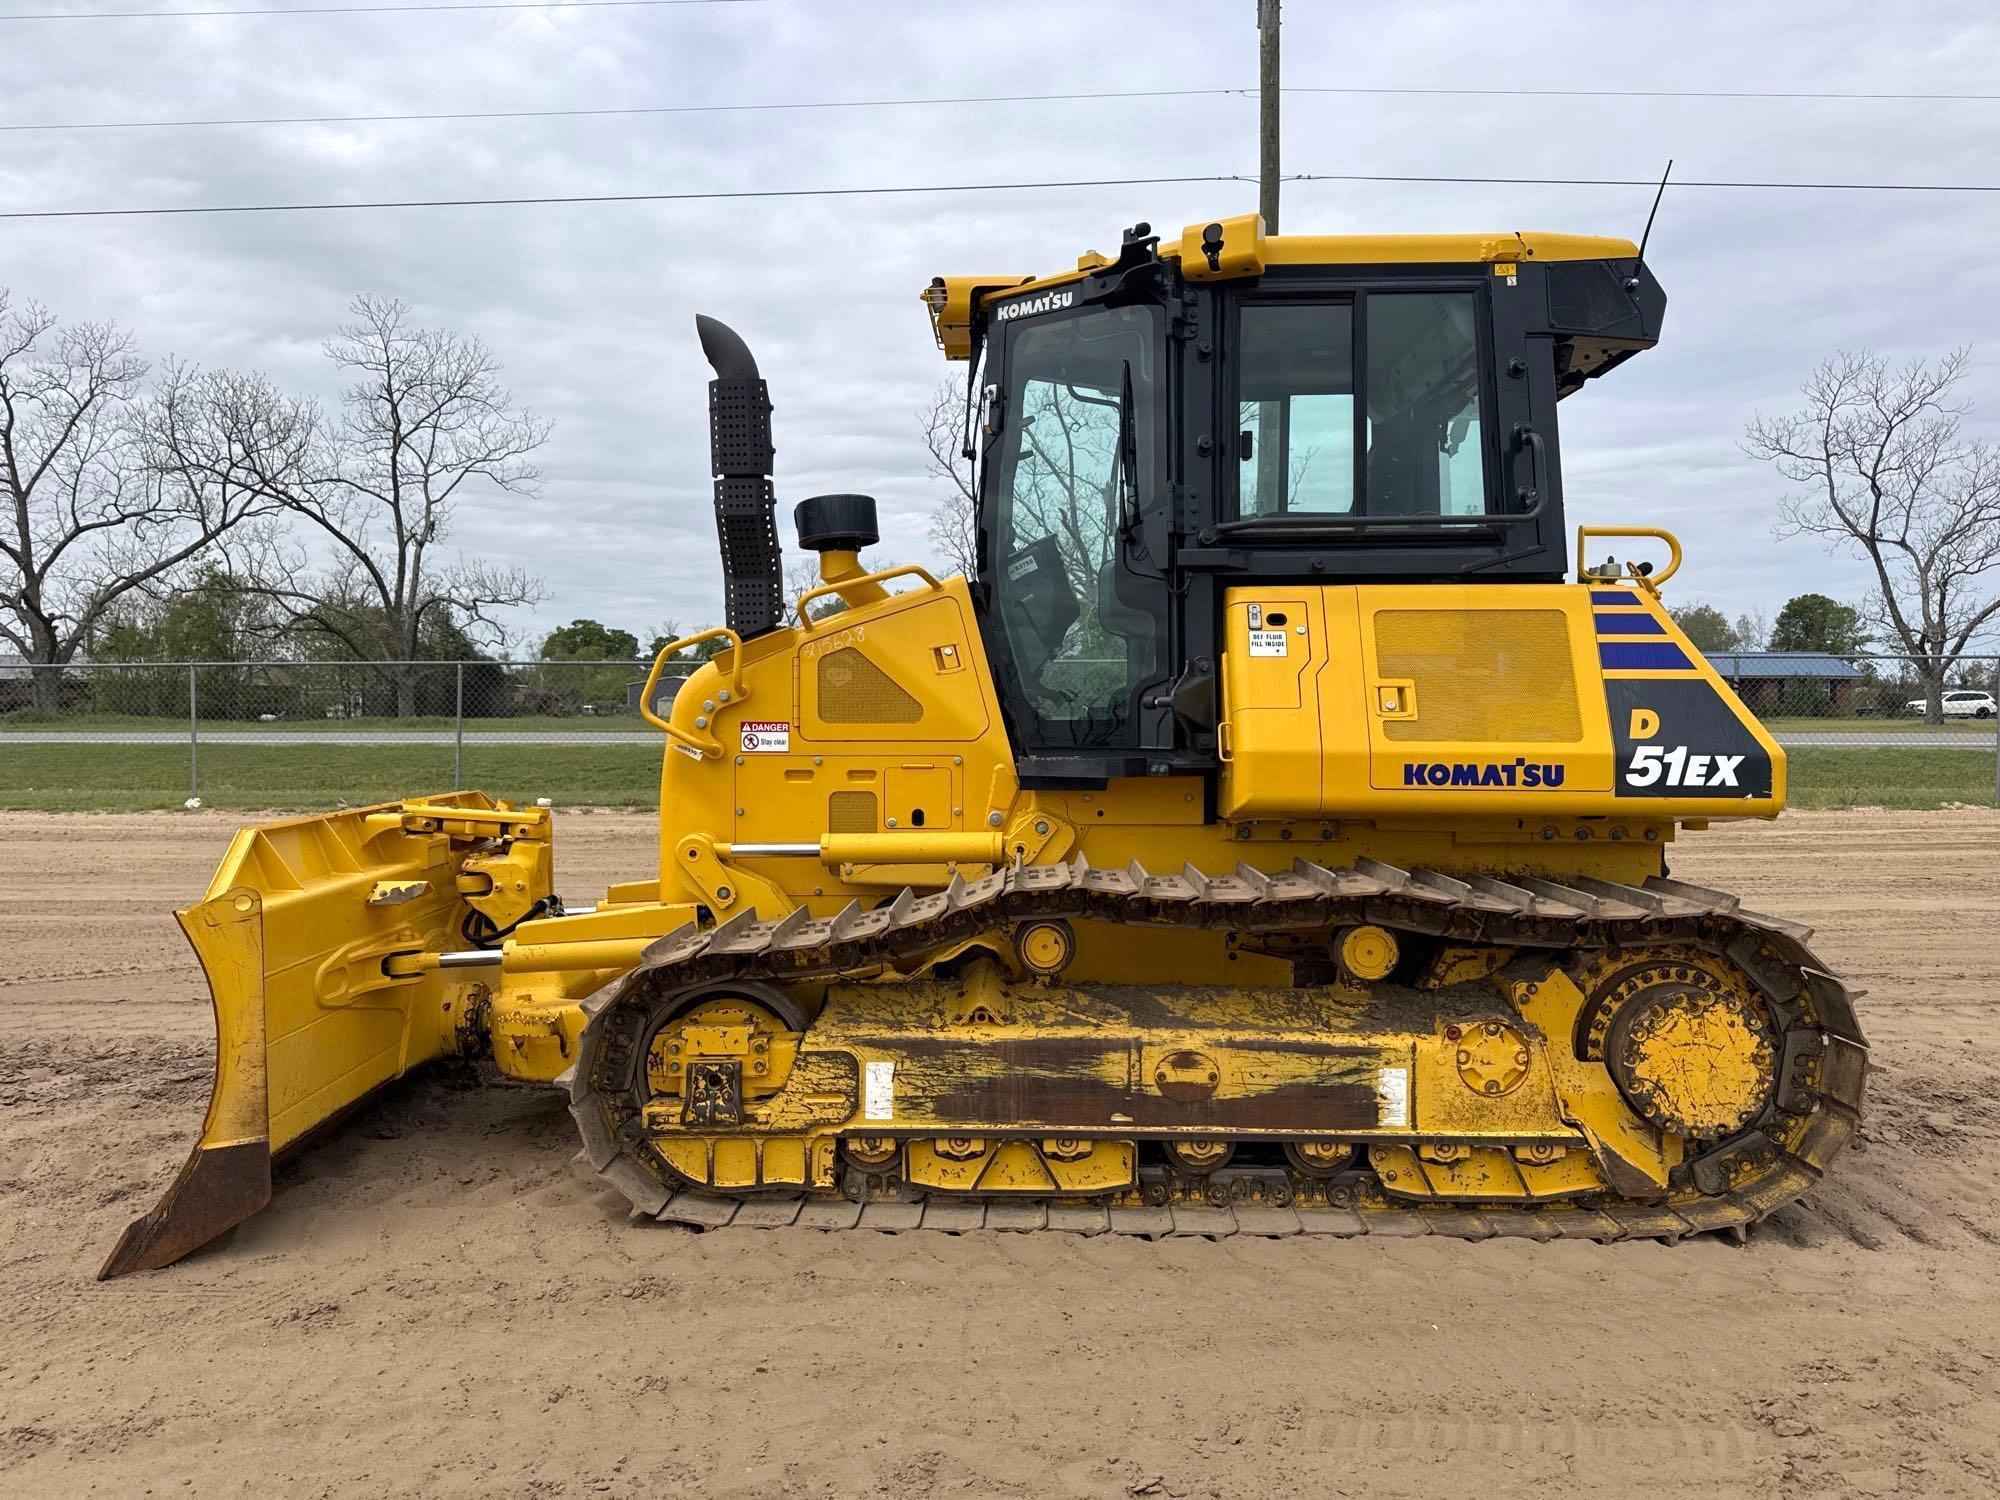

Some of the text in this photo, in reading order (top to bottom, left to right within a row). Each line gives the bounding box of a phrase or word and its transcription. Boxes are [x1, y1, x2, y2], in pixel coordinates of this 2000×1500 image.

[997, 291, 1073, 321] KOMATSU
[752, 723, 789, 732] DANGER
[1629, 708, 1660, 739] D
[760, 738, 787, 748] Stay clear
[1404, 758, 1564, 787] KOMATSU
[1625, 745, 1746, 787] 51EX
